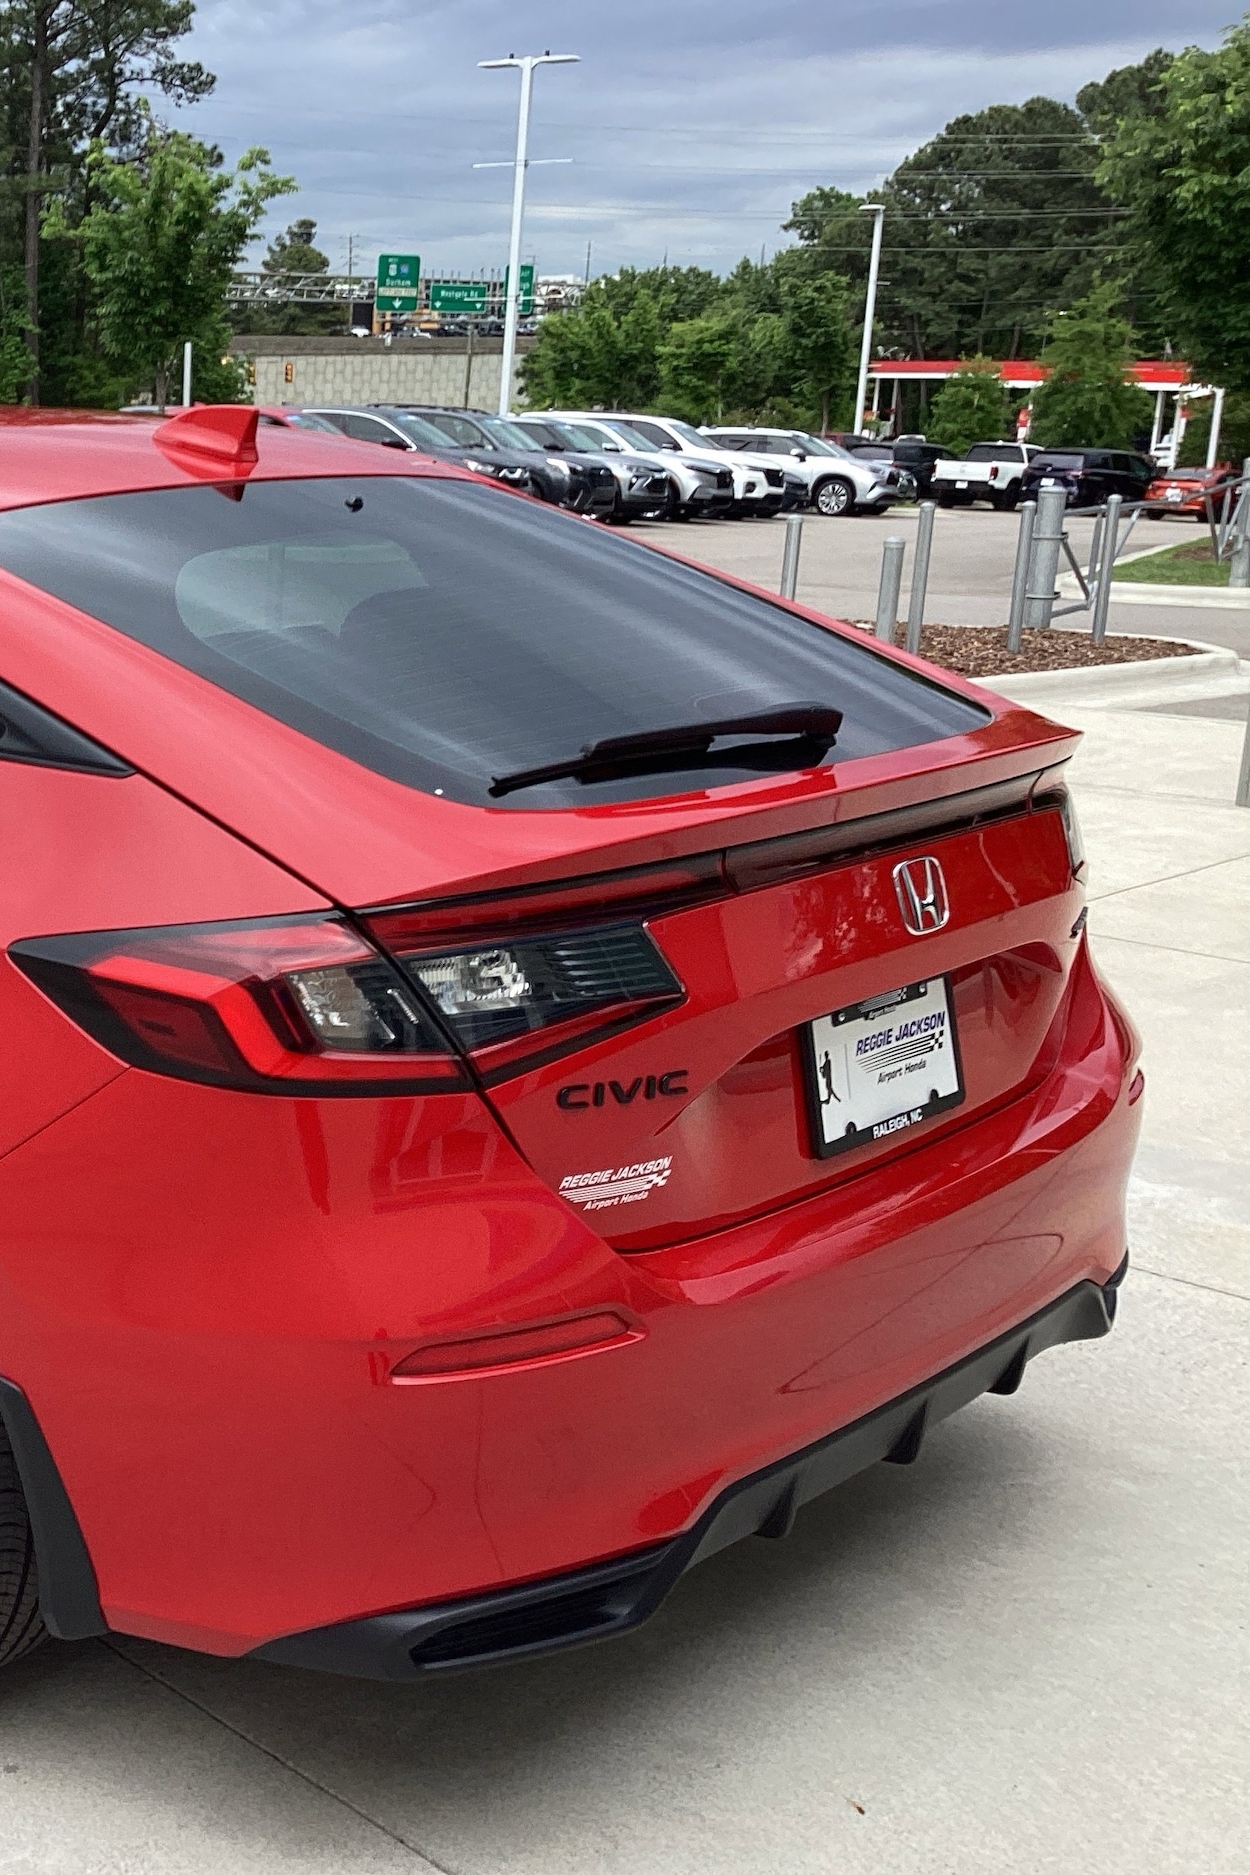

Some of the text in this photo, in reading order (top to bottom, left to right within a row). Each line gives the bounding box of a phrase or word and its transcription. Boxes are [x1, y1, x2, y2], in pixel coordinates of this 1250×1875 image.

[855, 1029, 894, 1056] REGGIE
[895, 1011, 946, 1043] JACKSON
[877, 1059, 927, 1085] Airport Honda
[556, 1070, 689, 1110] CIVIC
[910, 1108, 923, 1124] NC
[559, 1156, 673, 1190] REGGIE JACKSON
[583, 1191, 648, 1211] Airport Honda
